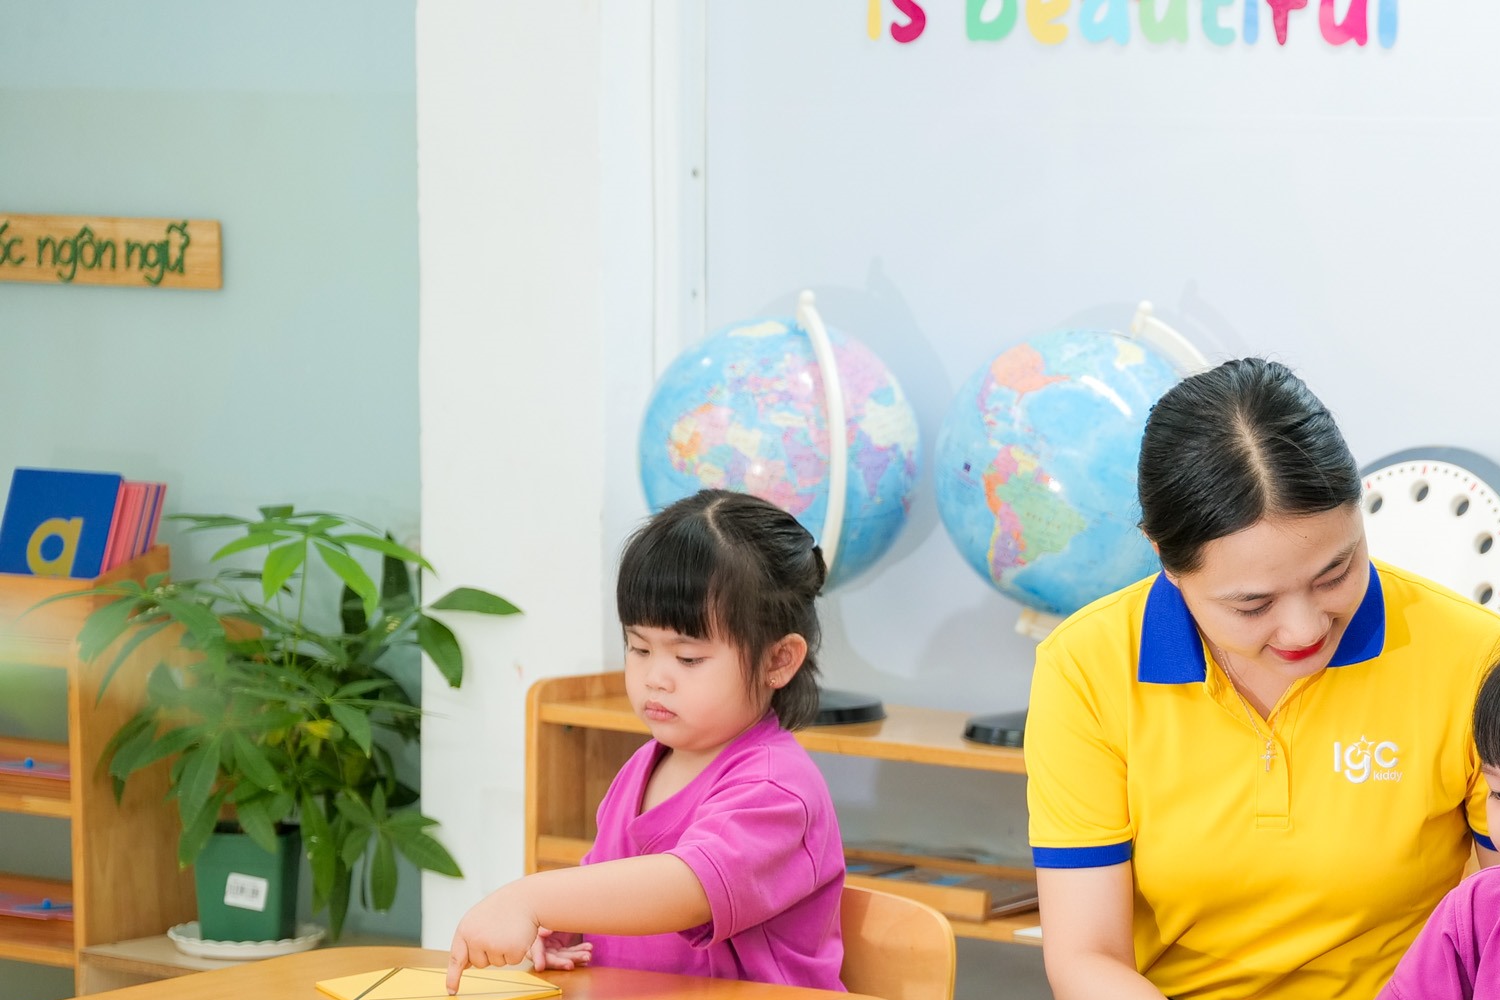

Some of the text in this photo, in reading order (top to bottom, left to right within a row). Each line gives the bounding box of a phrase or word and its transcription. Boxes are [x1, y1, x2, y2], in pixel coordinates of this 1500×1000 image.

[37, 225, 116, 283] ngôn
[26, 517, 84, 577] a
[1373, 769, 1403, 783] kiddy
